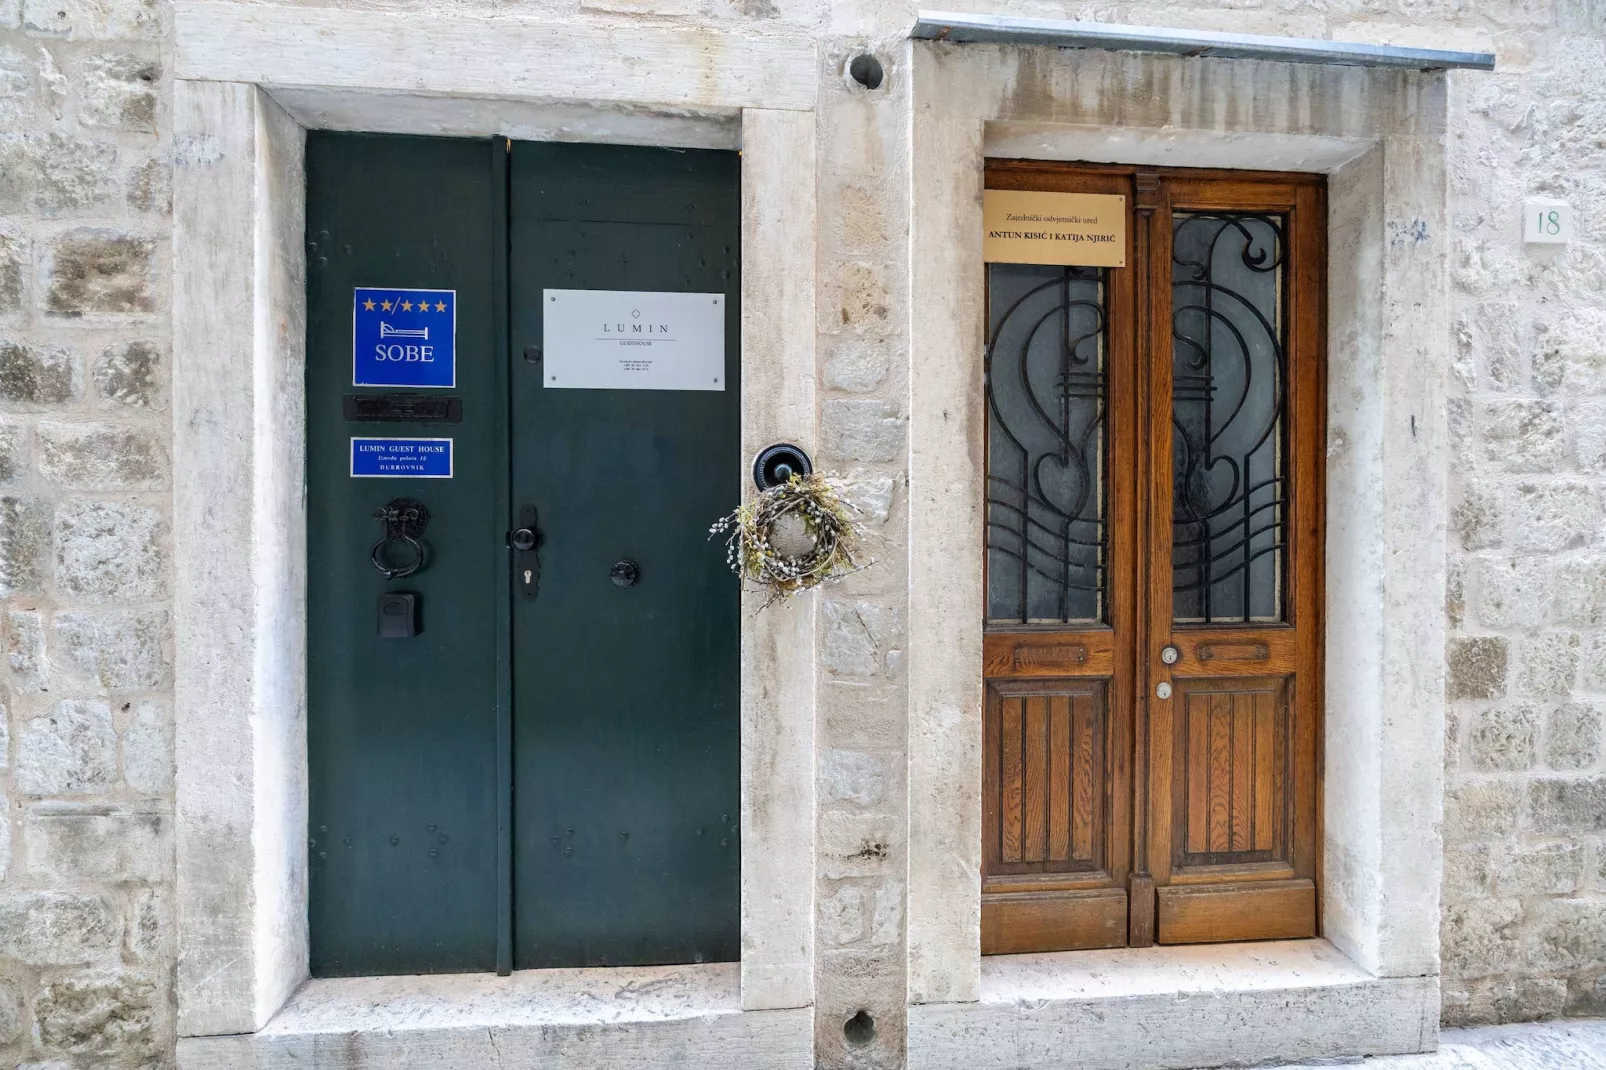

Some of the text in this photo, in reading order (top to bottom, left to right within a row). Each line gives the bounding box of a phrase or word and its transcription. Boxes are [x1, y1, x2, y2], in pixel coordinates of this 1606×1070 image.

[1006, 213, 1098, 225] Zajednički odvjetnički ured
[1538, 211, 1560, 235] 18
[988, 230, 1116, 244] ANTUN KISIĆ I KATIJA NJIRIĆ
[603, 324, 668, 333] LUMIN
[375, 344, 434, 362] SOBE
[359, 444, 445, 453] LUMIN GUEST HOUSE
